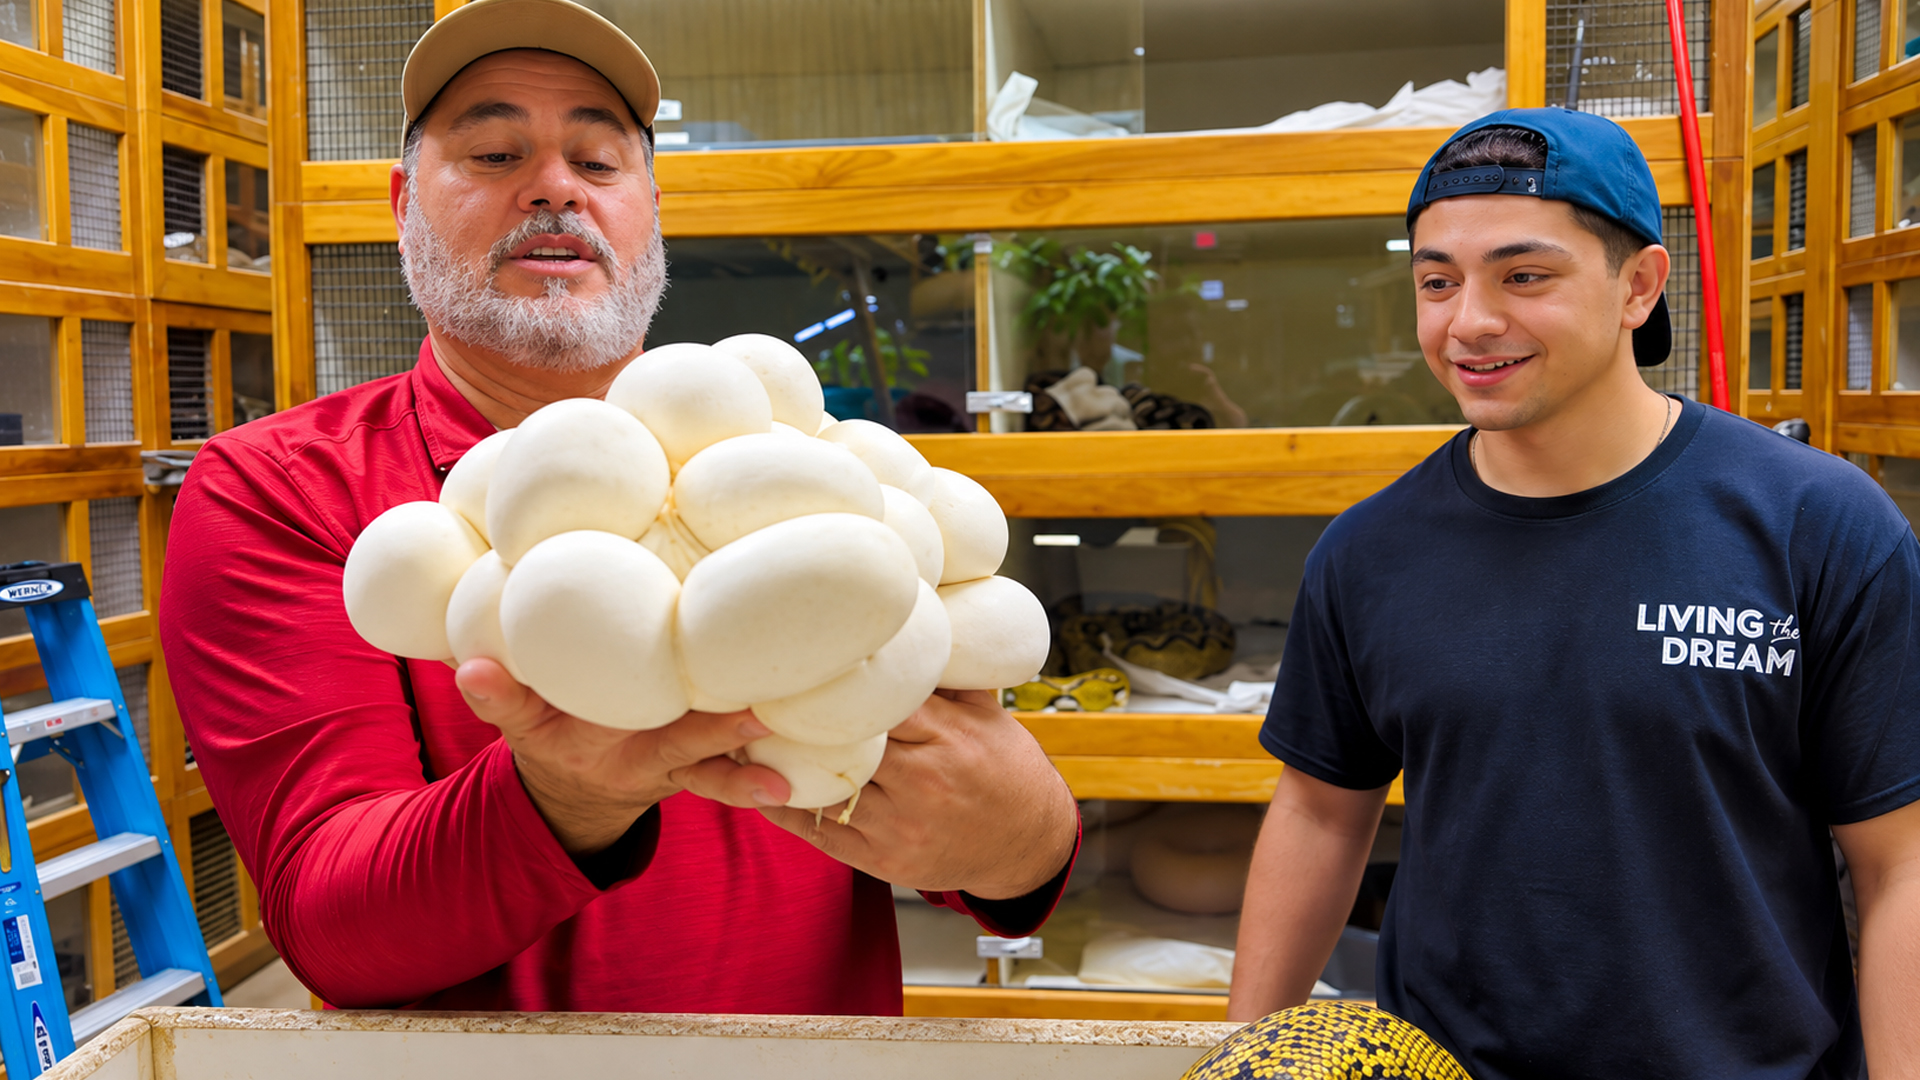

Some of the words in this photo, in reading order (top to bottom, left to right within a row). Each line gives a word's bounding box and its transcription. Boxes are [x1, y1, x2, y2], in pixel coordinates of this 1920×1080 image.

[1636, 603, 1765, 639] LIVING
[1769, 614, 1801, 641] the
[1661, 636, 1796, 677] DREAM
